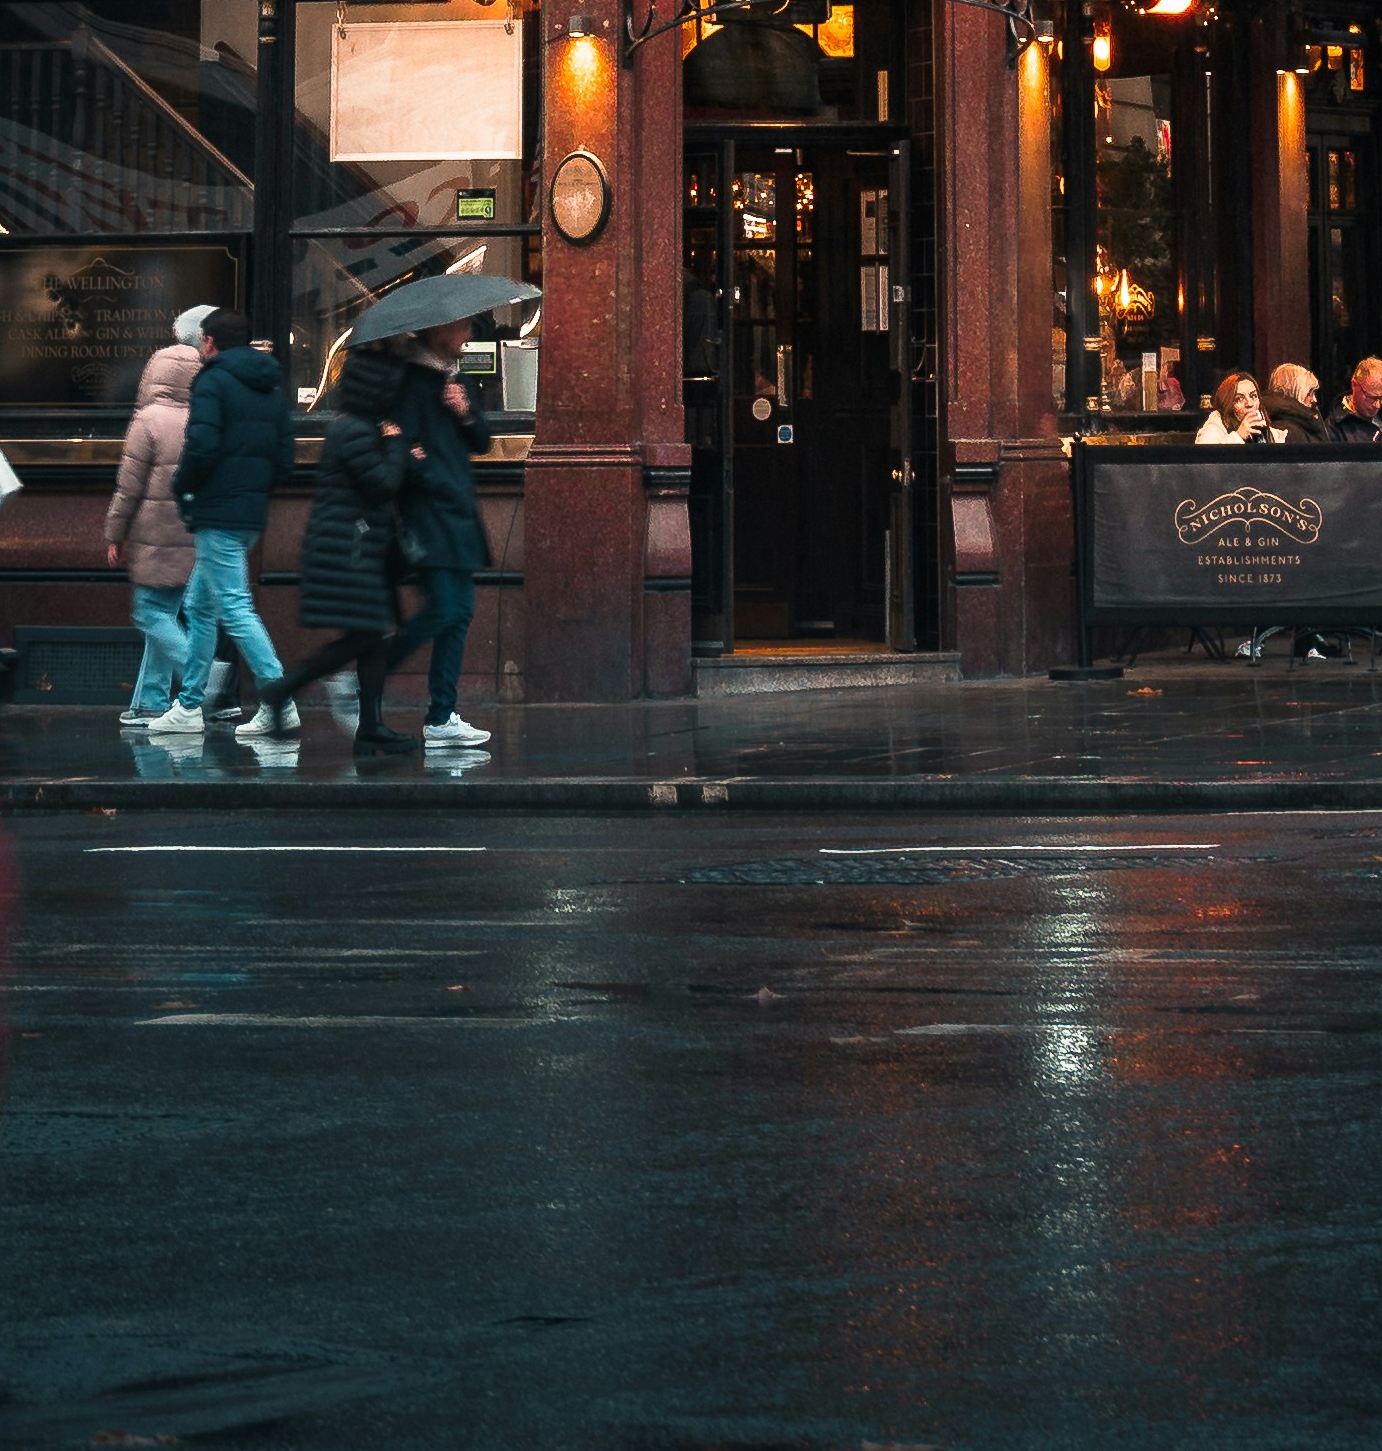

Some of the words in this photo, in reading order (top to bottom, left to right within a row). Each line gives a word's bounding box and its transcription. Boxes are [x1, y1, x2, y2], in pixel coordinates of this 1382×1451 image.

[67, 276, 165, 290] WELLINGTON
[8, 328, 42, 340] CASK
[96, 328, 119, 340] GIN
[21, 345, 68, 358] DINING
[71, 345, 111, 358] ROOM
[1190, 503, 1308, 532] NICHOLSON'S
[1218, 537, 1240, 547] ALE
[1245, 537, 1252, 547] &
[1257, 537, 1279, 547] GIN
[1198, 555, 1301, 565] ESTABLISHMENTS
[1218, 573, 1253, 583] SINCE
[1258, 573, 1282, 583] 1873
